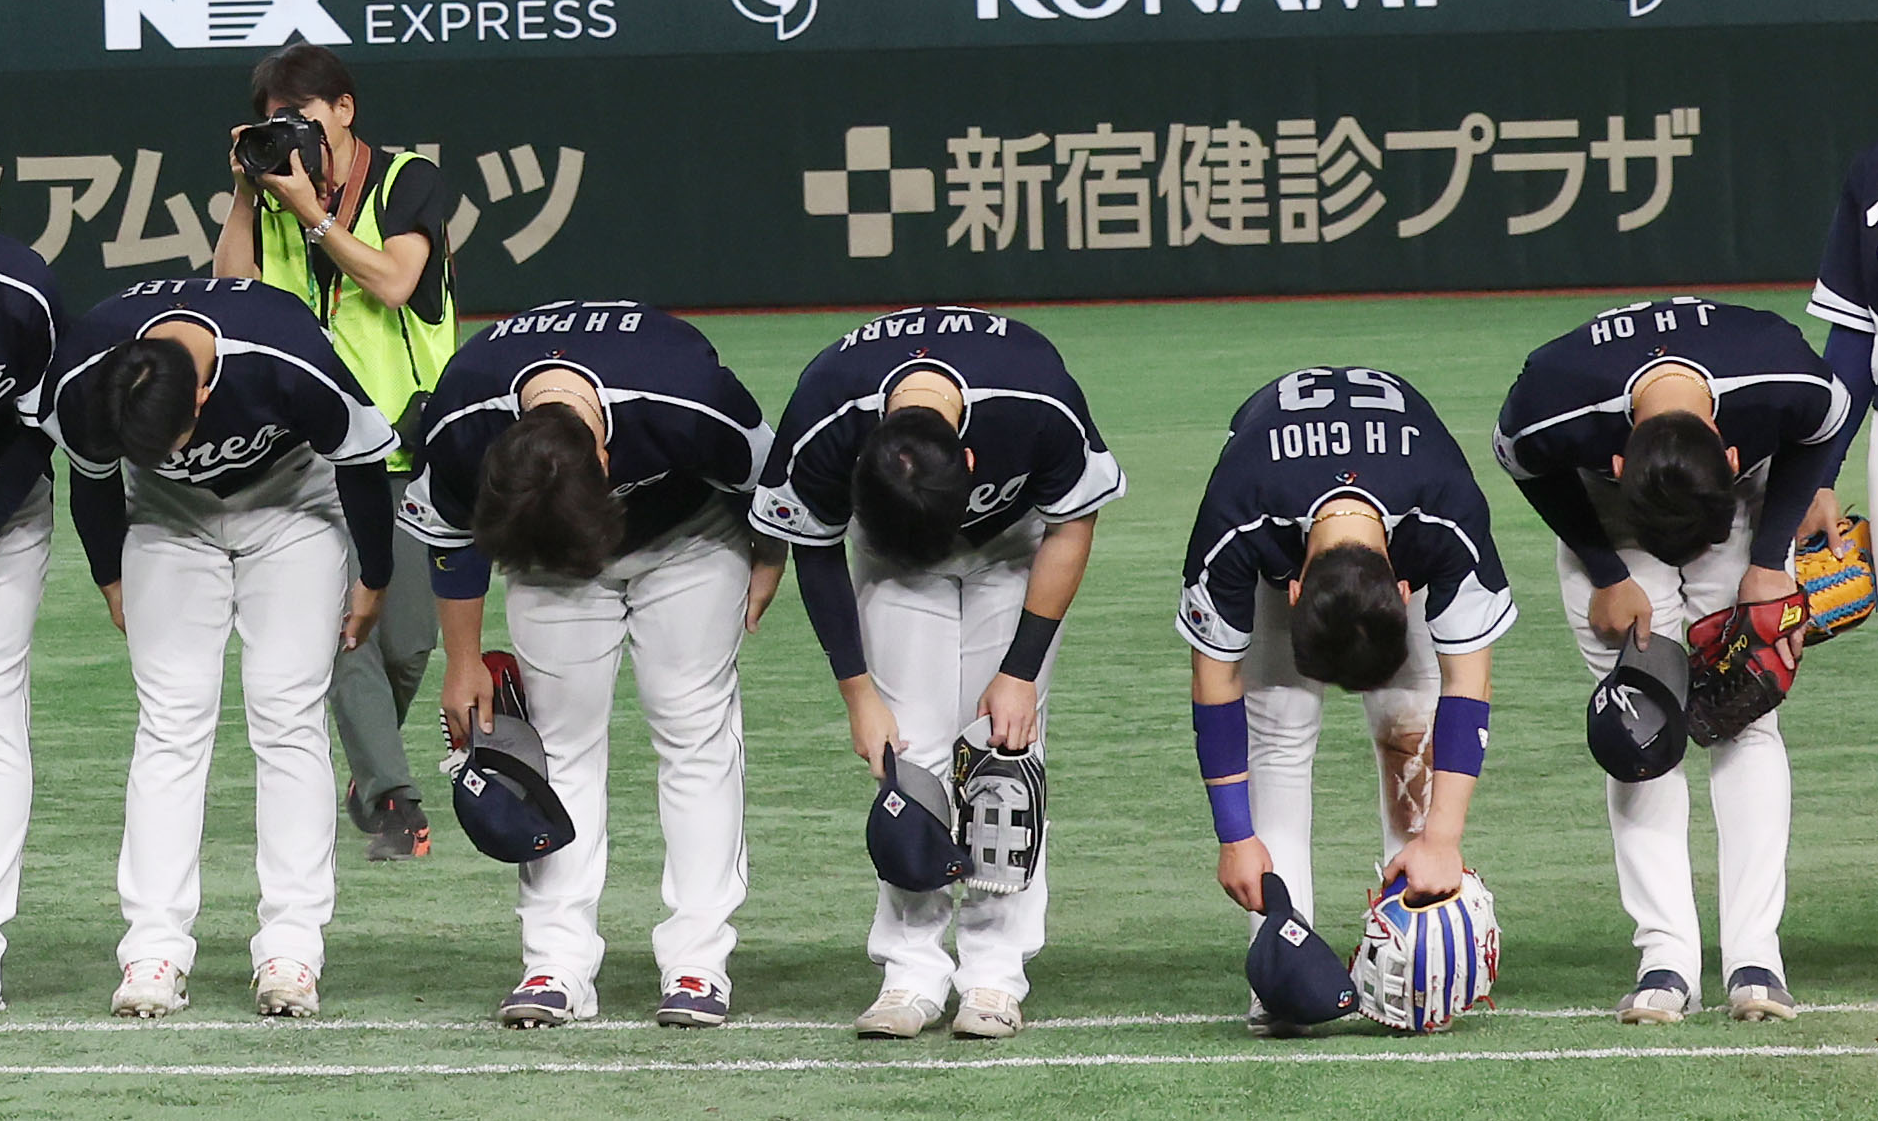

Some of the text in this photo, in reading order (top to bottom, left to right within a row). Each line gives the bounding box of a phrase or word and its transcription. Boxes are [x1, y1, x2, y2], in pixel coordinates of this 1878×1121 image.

[946, 106, 1701, 253] 新宿健診プラザ
[489, 312, 642, 341] B H PARK
[1590, 316, 1635, 346] OH
[1654, 309, 1677, 332] H
[1697, 303, 1716, 326] J
[839, 314, 1007, 352] K W PARK
[1277, 367, 1406, 413] 53
[1269, 421, 1420, 461] J H CHOI
